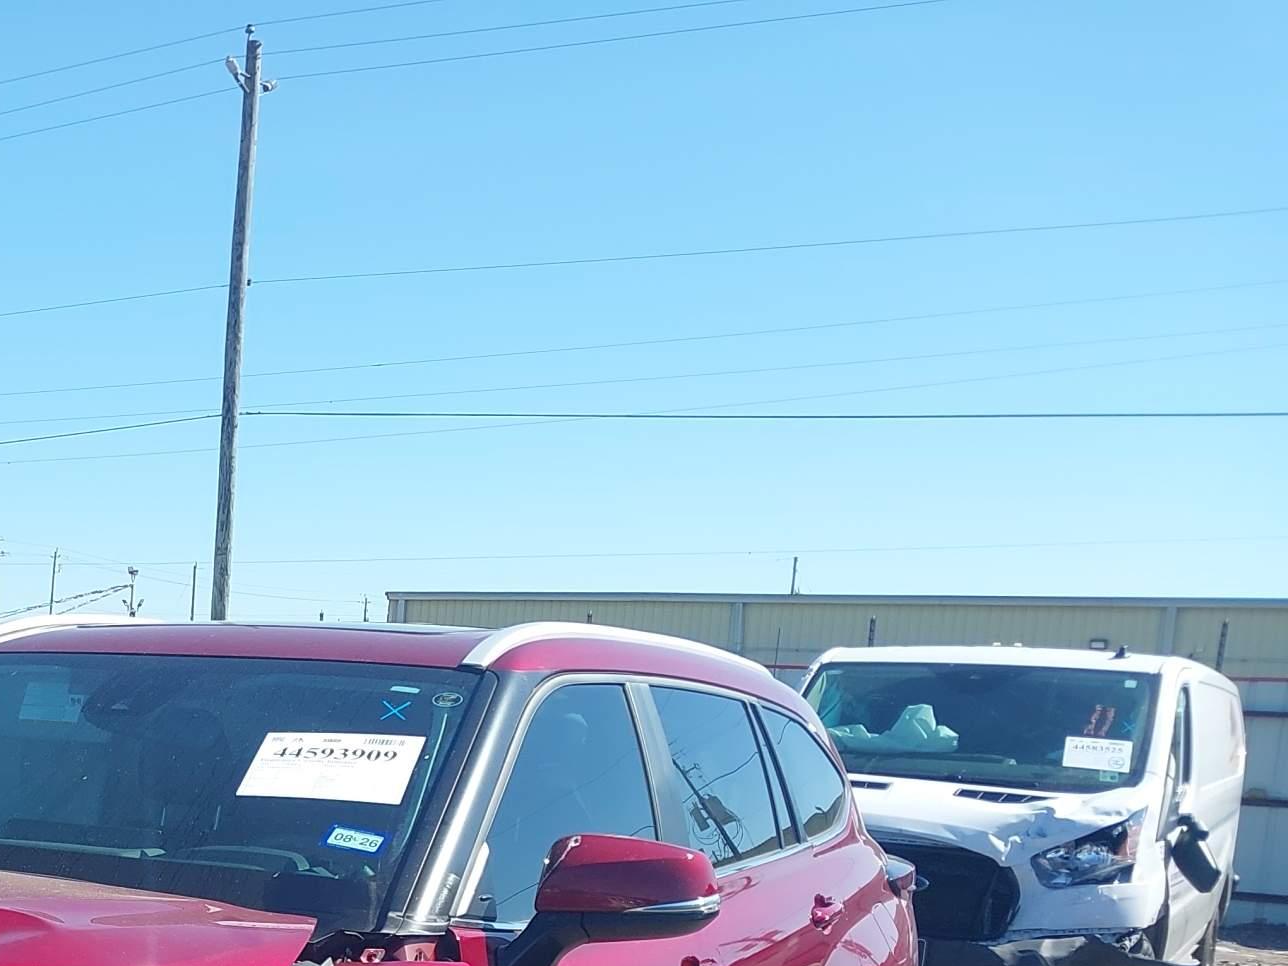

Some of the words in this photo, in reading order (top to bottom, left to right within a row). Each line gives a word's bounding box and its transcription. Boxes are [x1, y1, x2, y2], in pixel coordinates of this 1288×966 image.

[273, 746, 398, 761] 44593909
[334, 832, 354, 843] 08
[358, 837, 379, 848] 26
